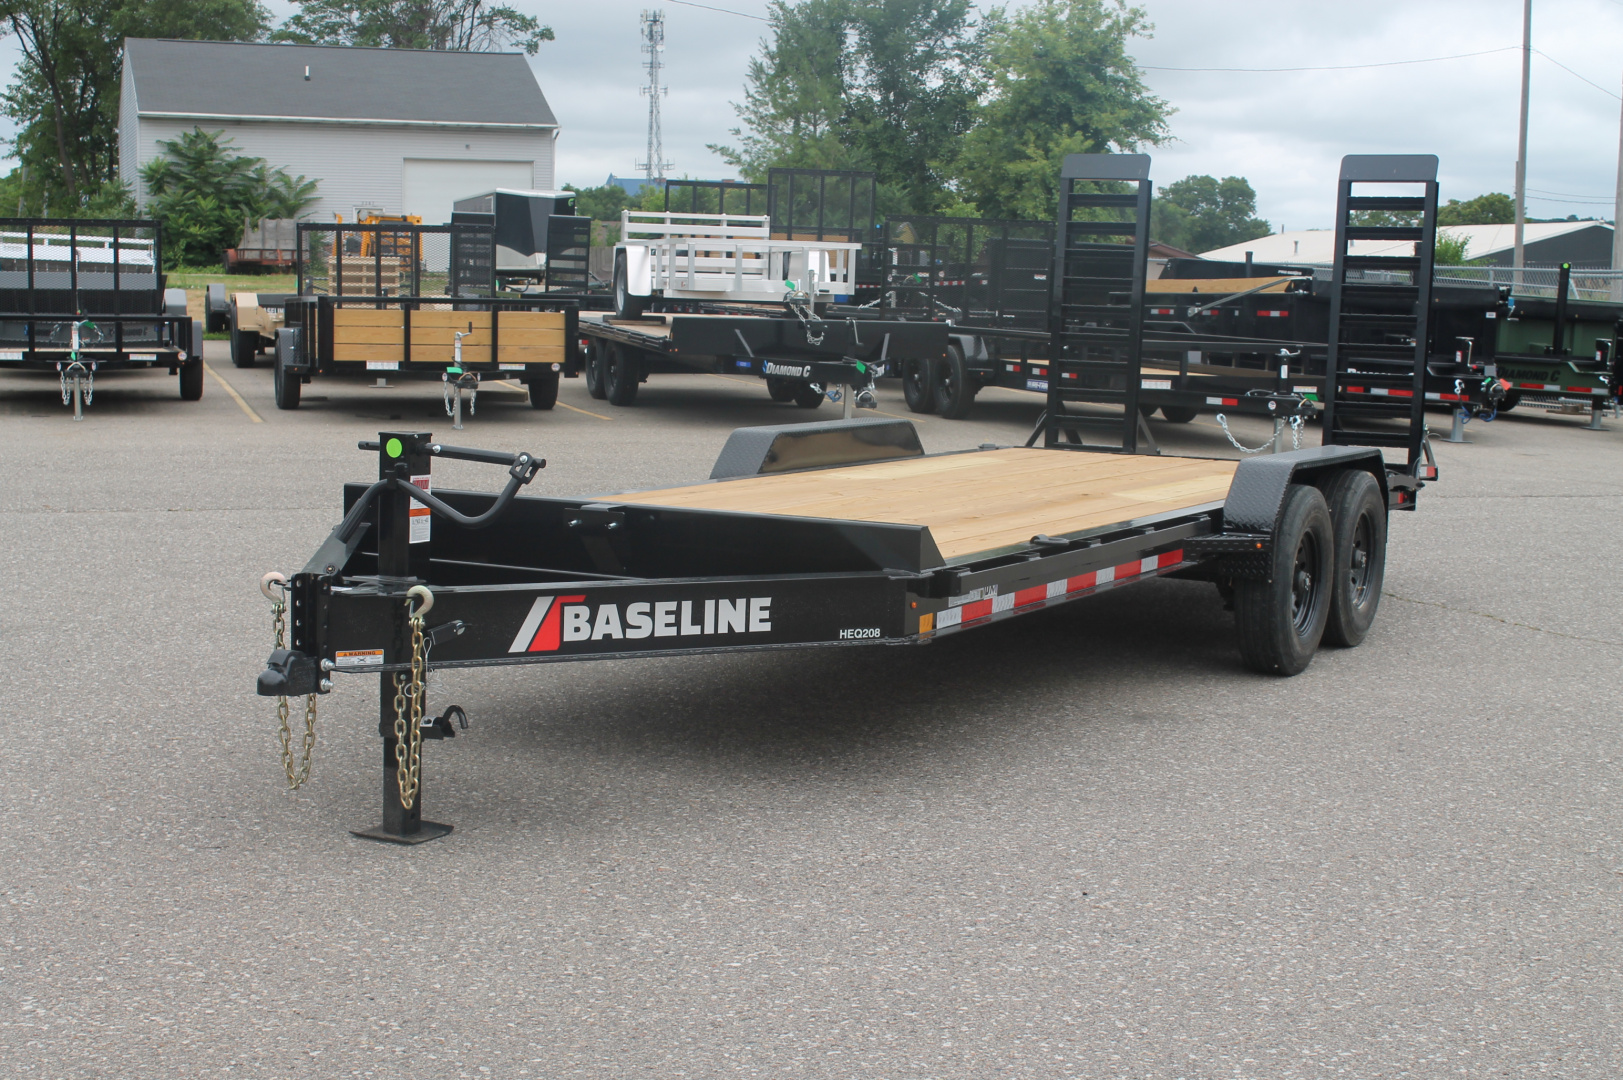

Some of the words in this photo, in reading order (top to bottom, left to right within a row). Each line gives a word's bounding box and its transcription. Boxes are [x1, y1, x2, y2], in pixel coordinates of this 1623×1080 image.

[765, 362, 802, 377] DIAMOND
[803, 365, 811, 378] C
[563, 597, 772, 642] BASELINE
[839, 628, 881, 639] HEQ208
